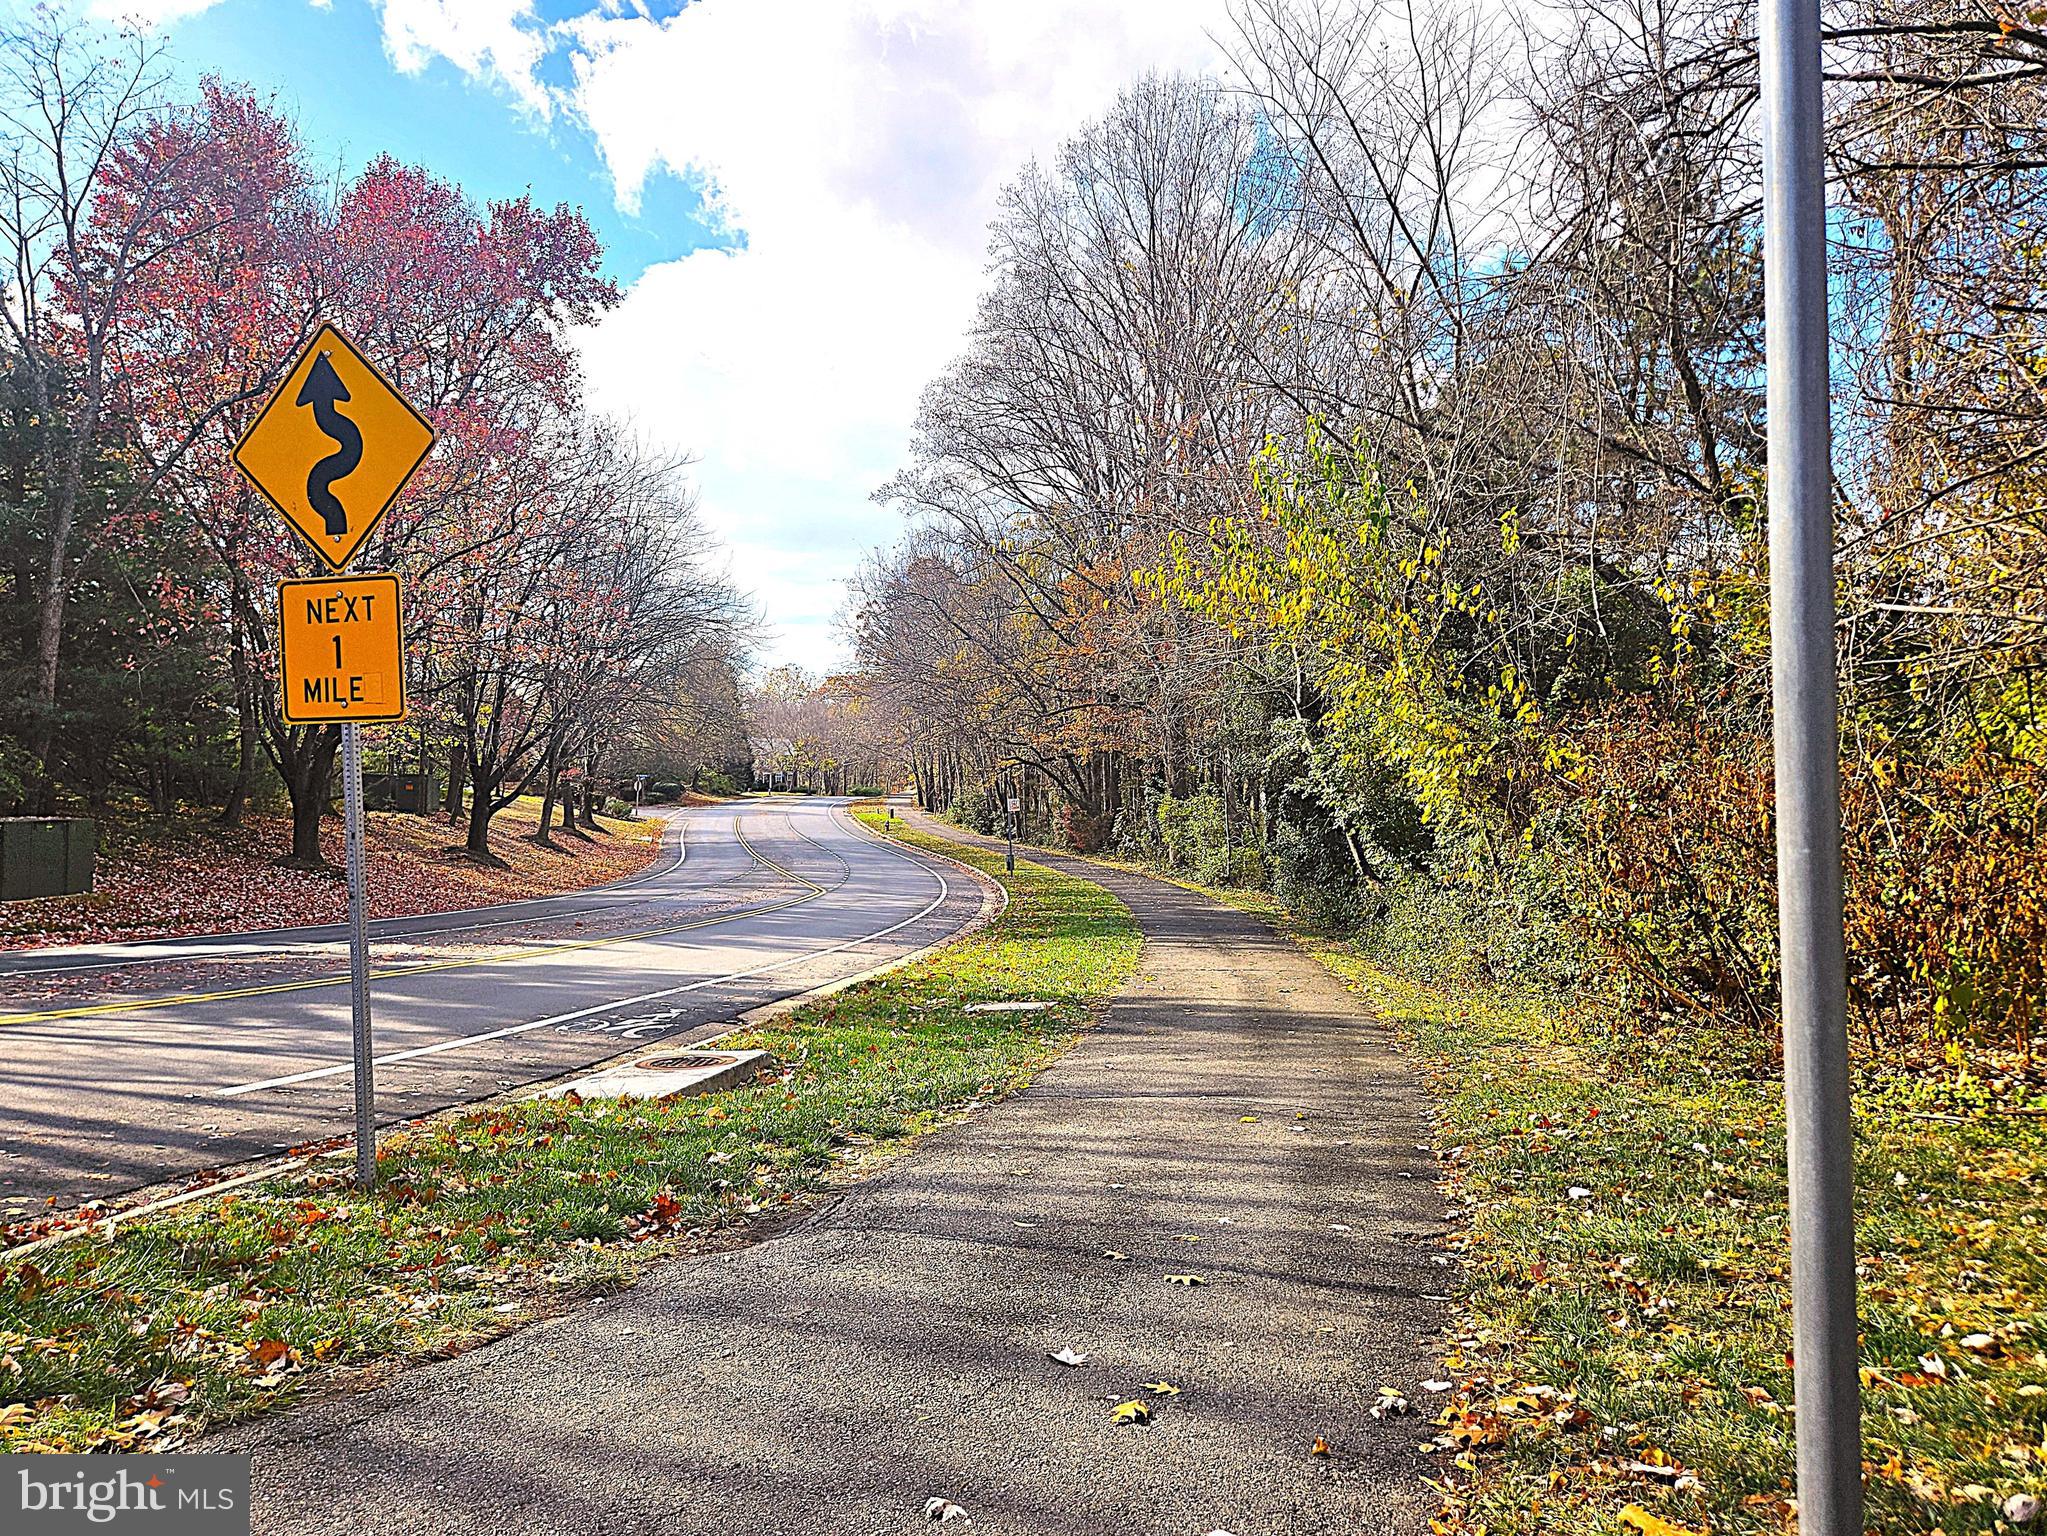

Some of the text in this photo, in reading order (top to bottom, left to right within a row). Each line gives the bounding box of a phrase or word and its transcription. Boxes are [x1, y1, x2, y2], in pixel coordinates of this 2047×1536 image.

[307, 595, 375, 624] NEXT
[332, 635, 342, 670] 1
[303, 676, 364, 704] MILE
